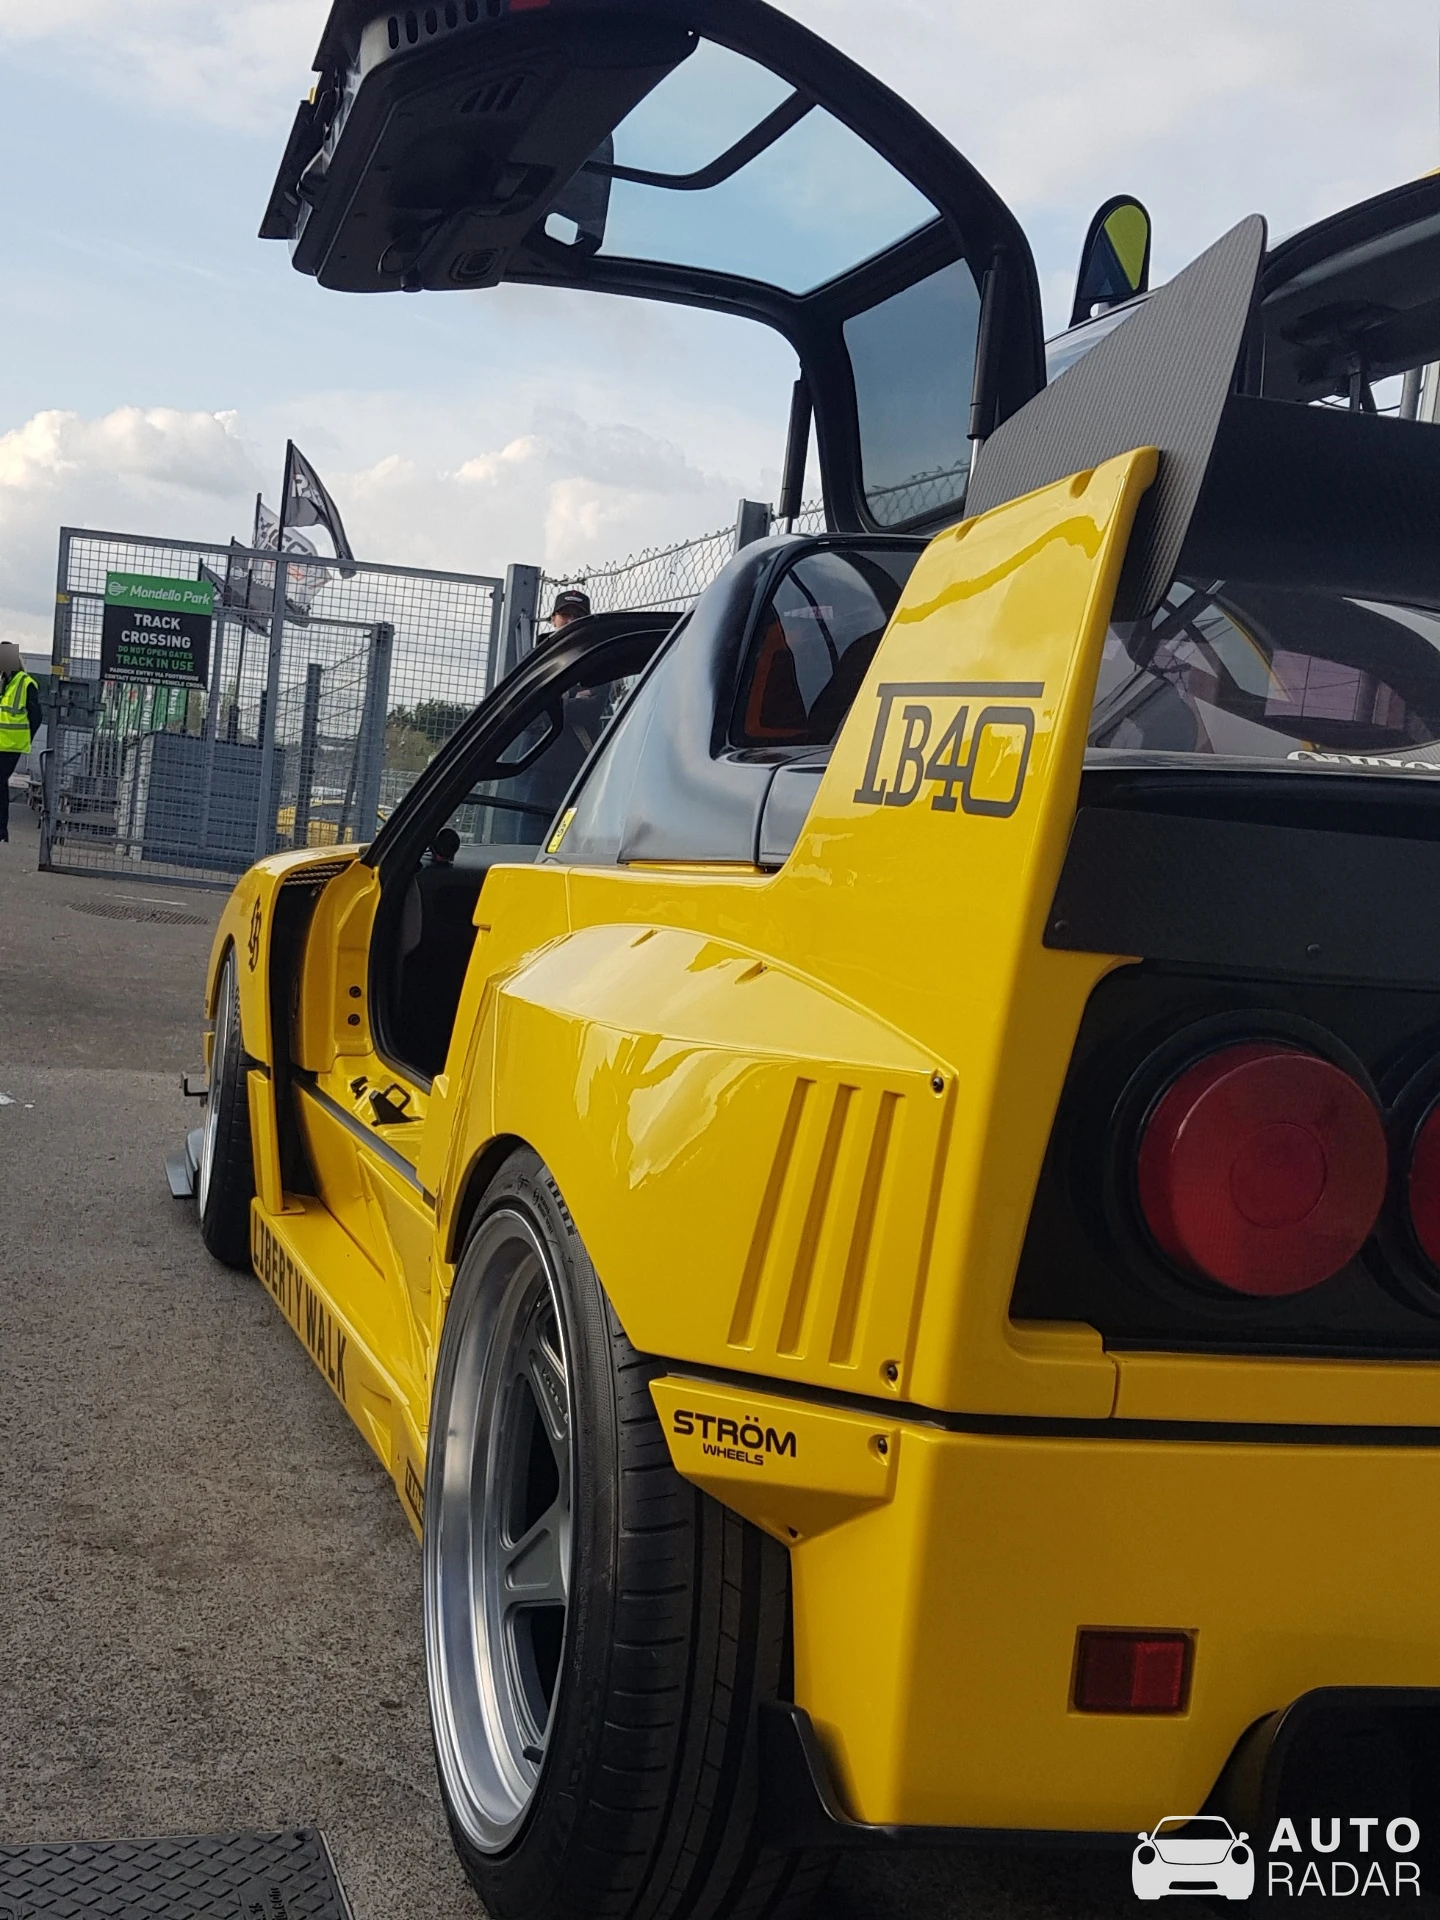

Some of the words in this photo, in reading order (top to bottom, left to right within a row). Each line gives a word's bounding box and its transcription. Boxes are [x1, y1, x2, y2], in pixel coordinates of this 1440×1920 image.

[130, 585, 181, 602] Mondello
[183, 591, 210, 605] Park
[134, 613, 181, 630] TRACK
[121, 630, 191, 649] CROSSING
[118, 645, 128, 653] DO
[130, 647, 146, 655] NOT
[147, 648, 167, 657] OPEN
[168, 650, 193, 660] GATES
[116, 654, 154, 668] TRACK
[156, 657, 169, 669] IN
[171, 659, 194, 672] USE
[104, 673, 129, 681] CONTACT
[136, 669, 154, 677] ENTRY
[853, 682, 1045, 818] LB40
[673, 1409, 796, 1458] STRÖM
[703, 1443, 764, 1466] WHEELS
